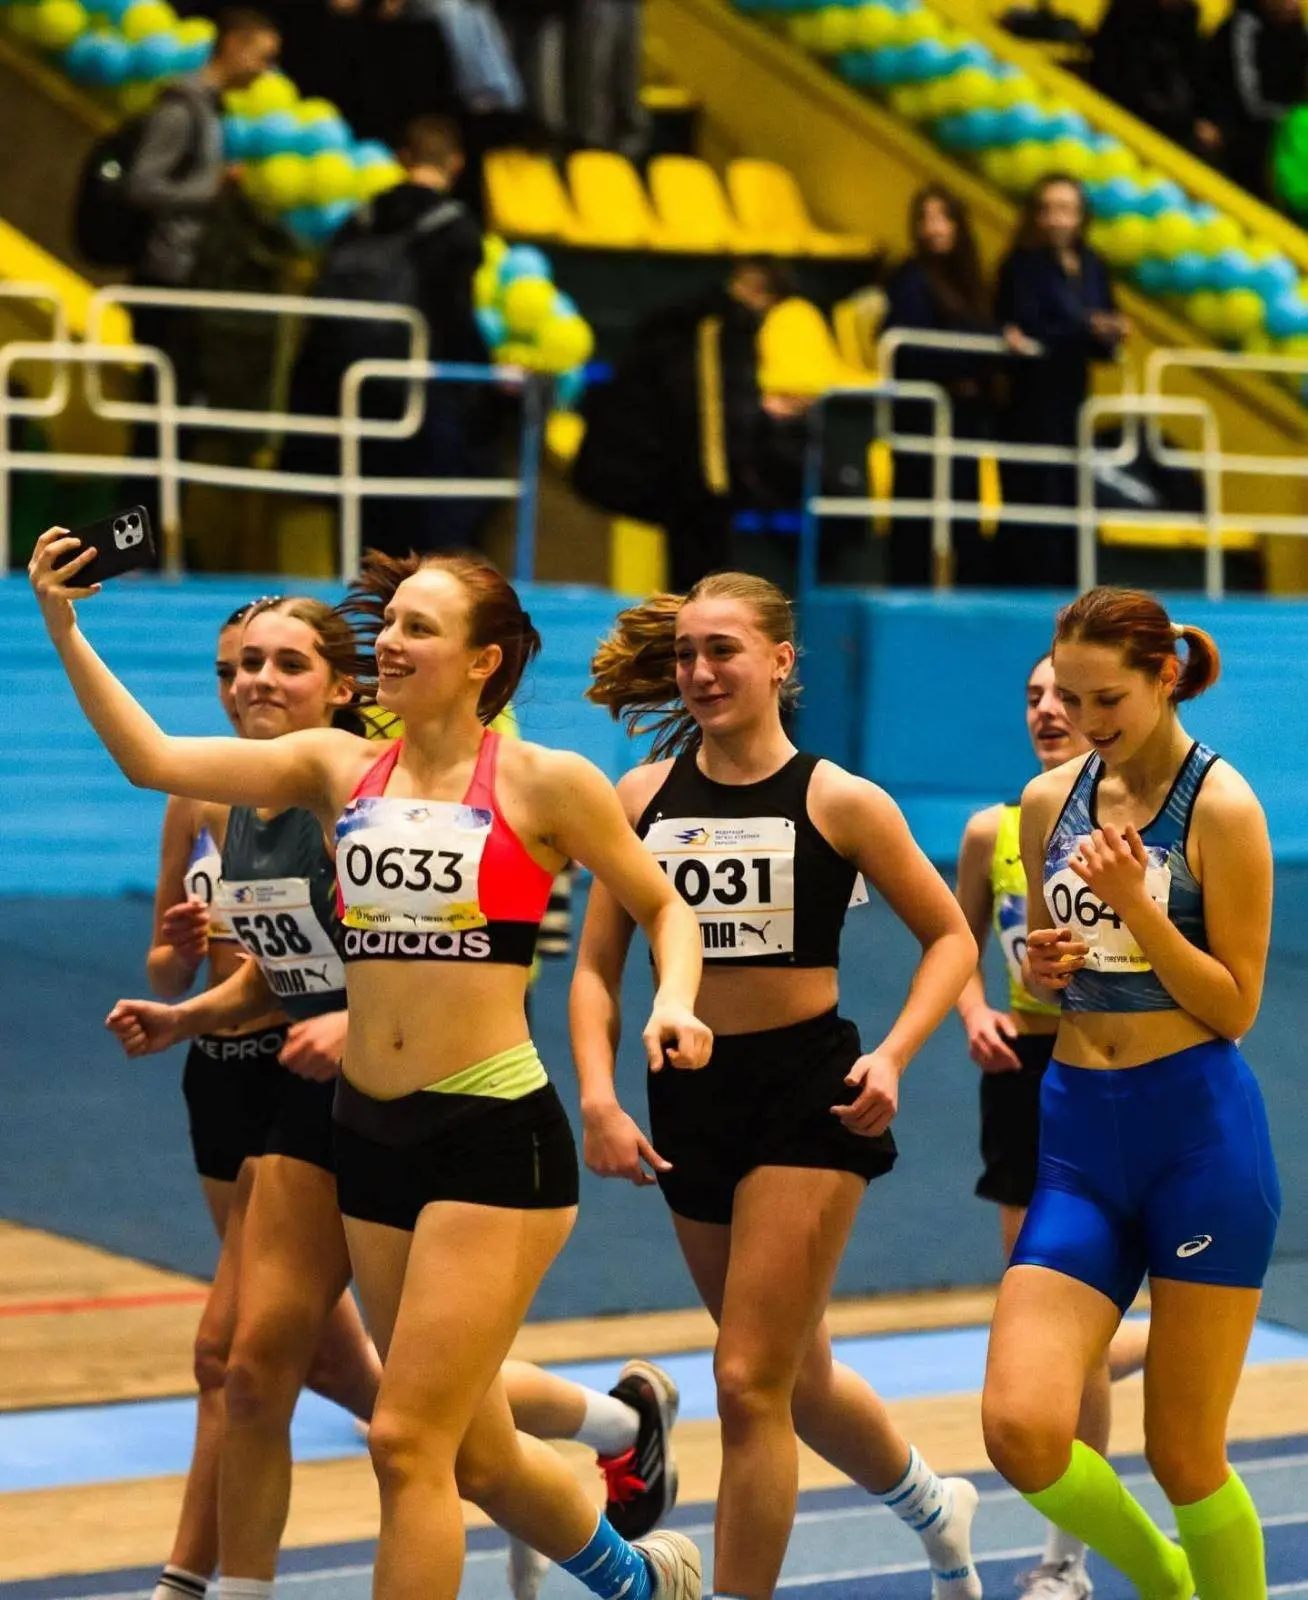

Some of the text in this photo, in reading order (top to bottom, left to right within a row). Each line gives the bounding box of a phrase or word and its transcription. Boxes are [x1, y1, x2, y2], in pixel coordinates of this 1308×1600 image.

[346, 843, 464, 893] 0633
[1052, 883, 1123, 929] 064
[232, 913, 313, 958] 538
[344, 929, 491, 959] adidas
